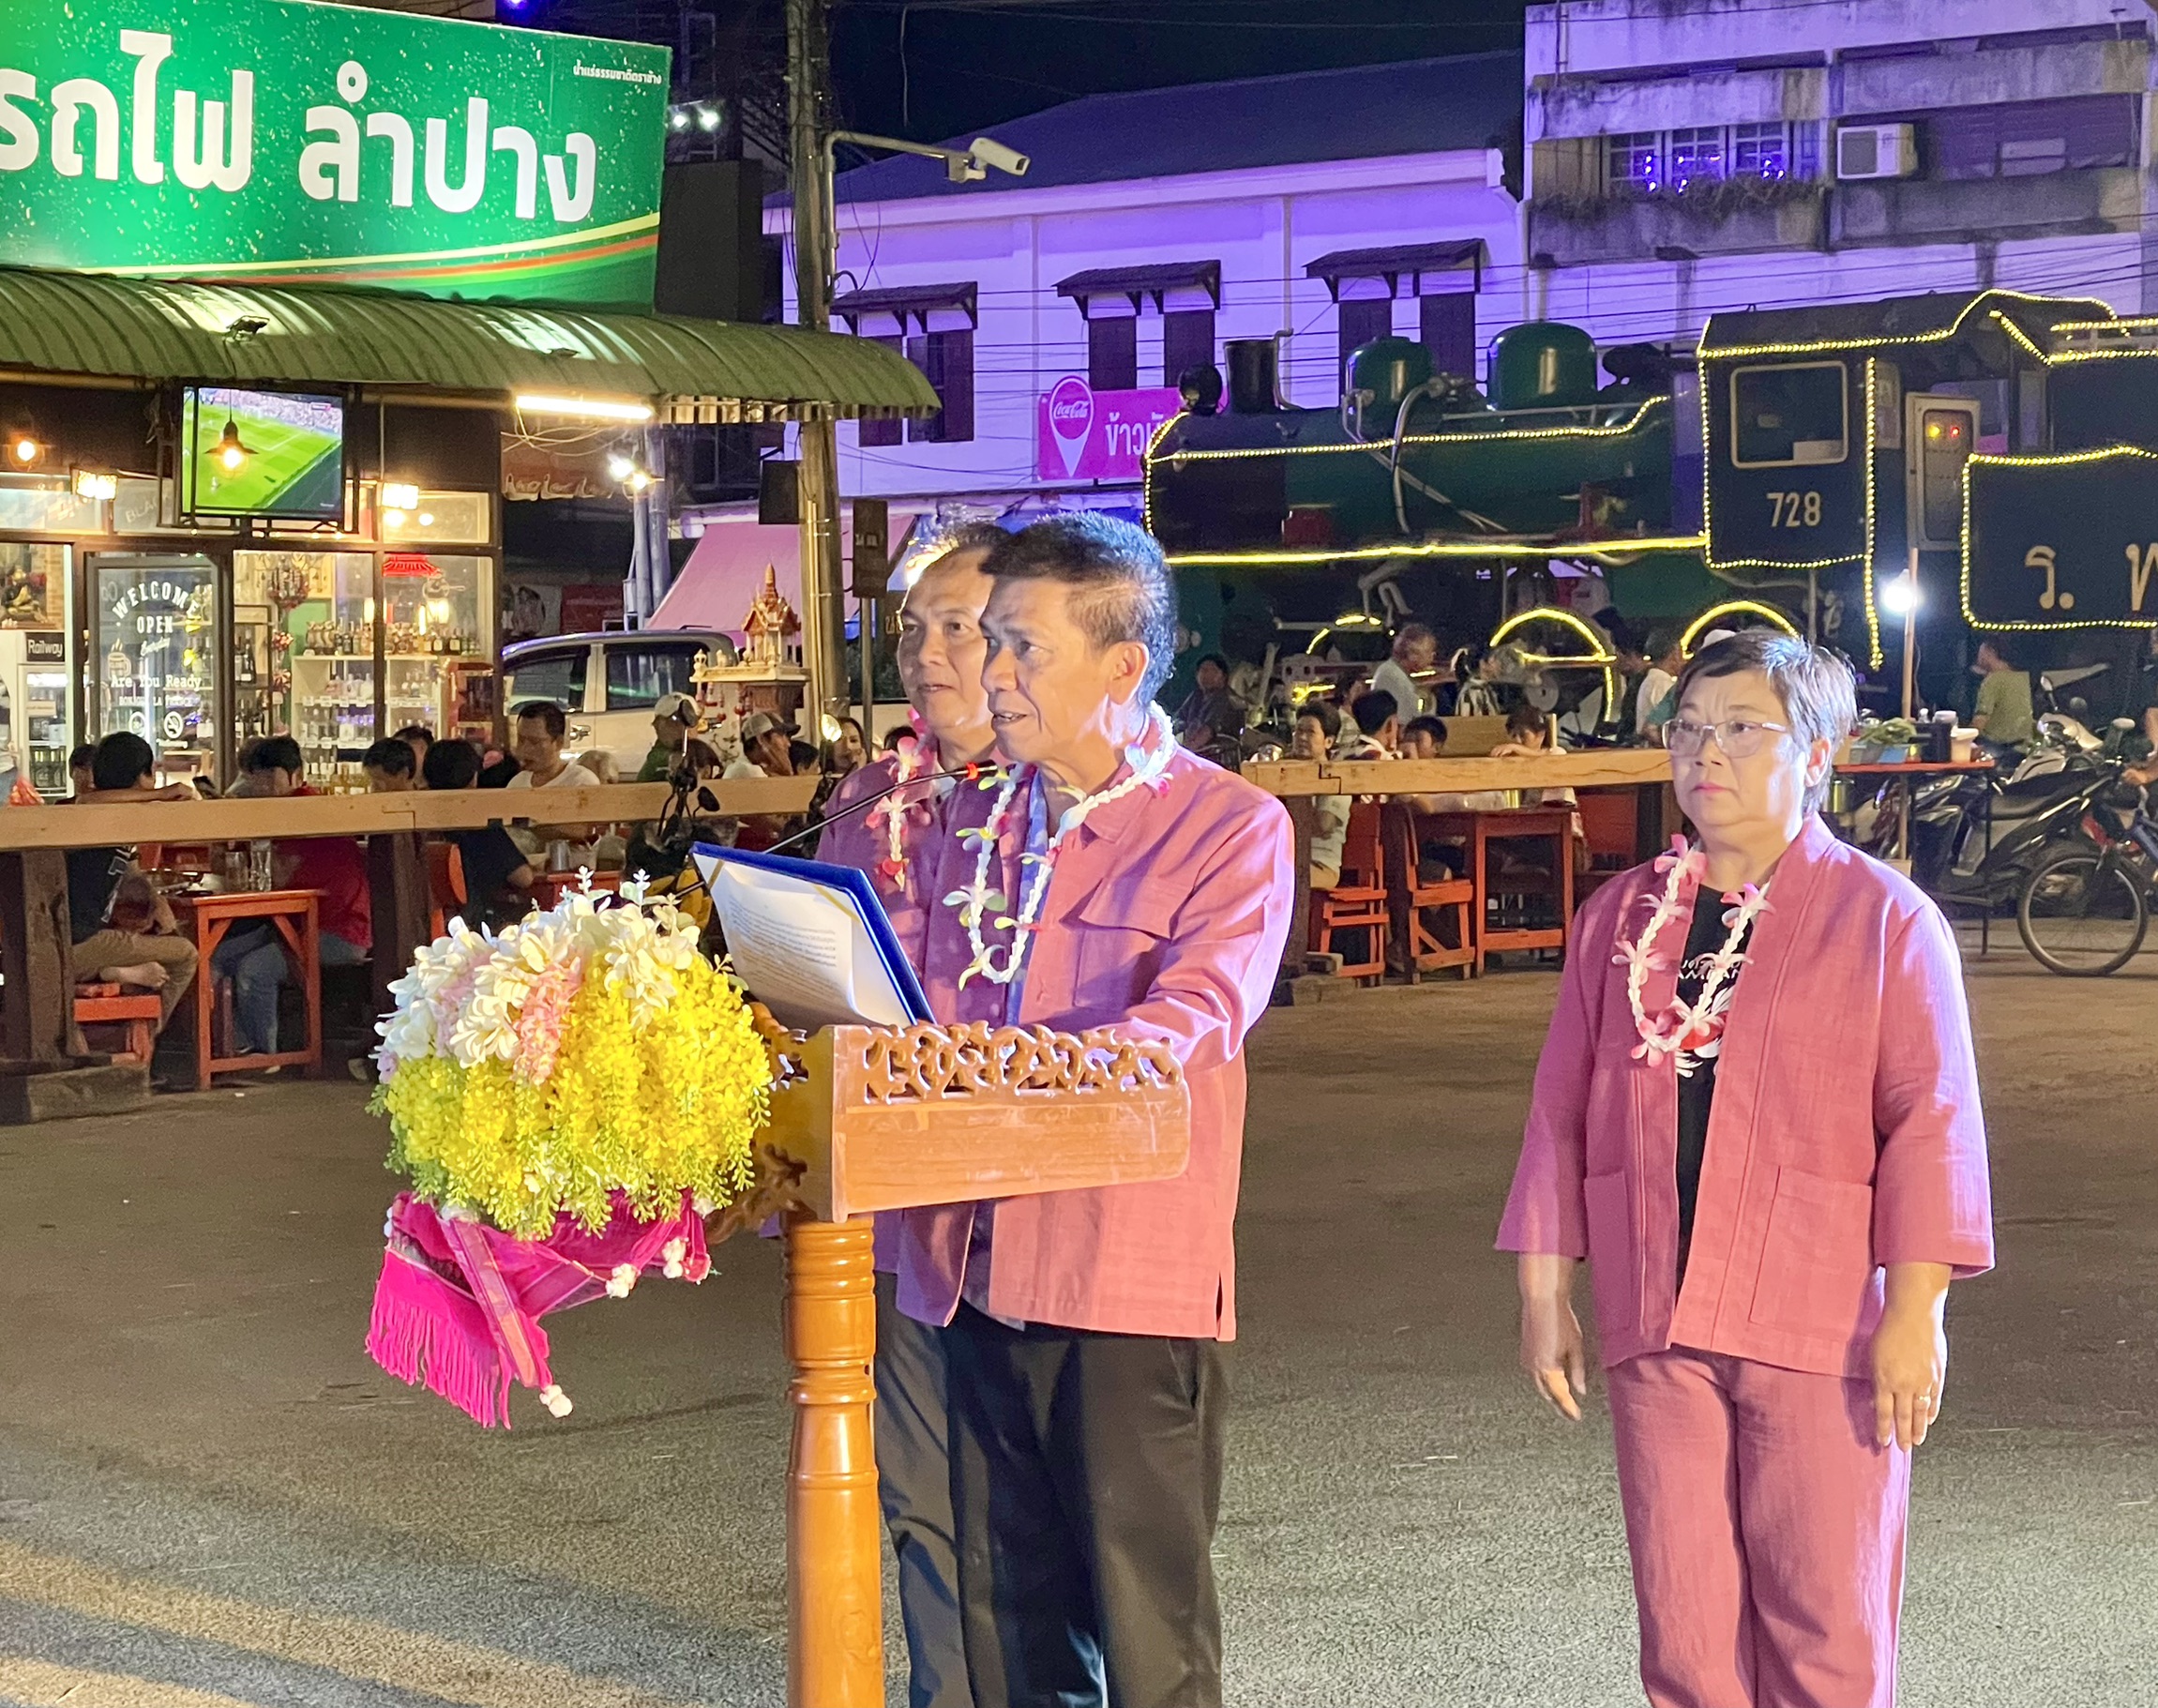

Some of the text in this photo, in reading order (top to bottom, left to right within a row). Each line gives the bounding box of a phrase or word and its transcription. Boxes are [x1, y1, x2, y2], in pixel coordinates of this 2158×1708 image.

[0, 29, 596, 222] รถไฟ ลำปาง
[1766, 491, 1821, 527] 728
[112, 581, 202, 619] WELCOME
[136, 615, 174, 633] OPEN
[27, 639, 64, 658] Railway
[111, 674, 202, 691] Are You Ready
